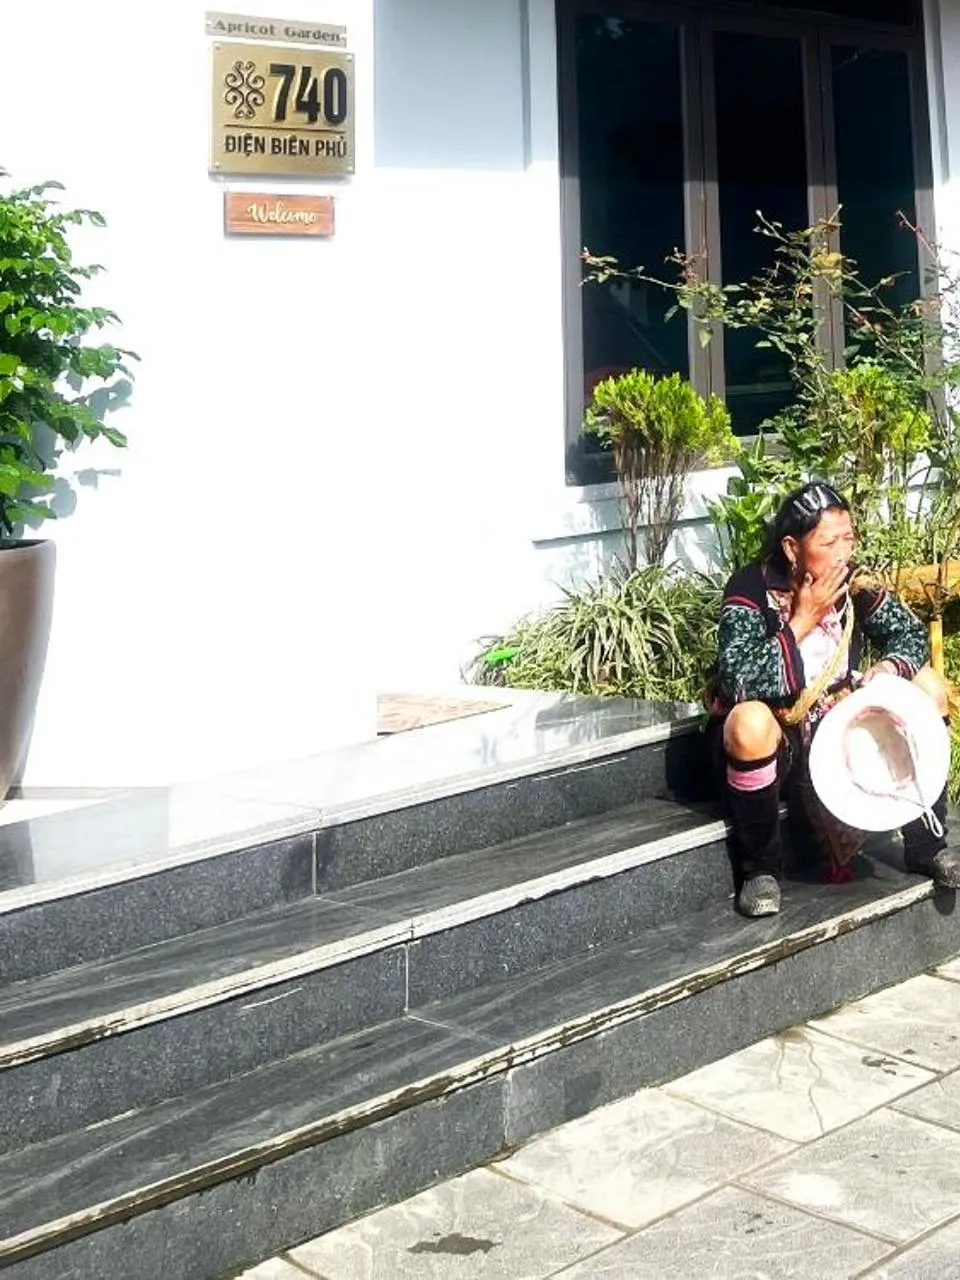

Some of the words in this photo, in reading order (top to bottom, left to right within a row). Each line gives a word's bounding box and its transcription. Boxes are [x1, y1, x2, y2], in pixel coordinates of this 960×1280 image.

[214, 18, 275, 35] Apricot
[284, 25, 341, 41] Garden
[268, 62, 348, 125] 740
[224, 131, 266, 157] ĐIỆN
[270, 135, 310, 156] BIÊN
[315, 135, 348, 158] PHỦ
[246, 200, 318, 224] Welcome
